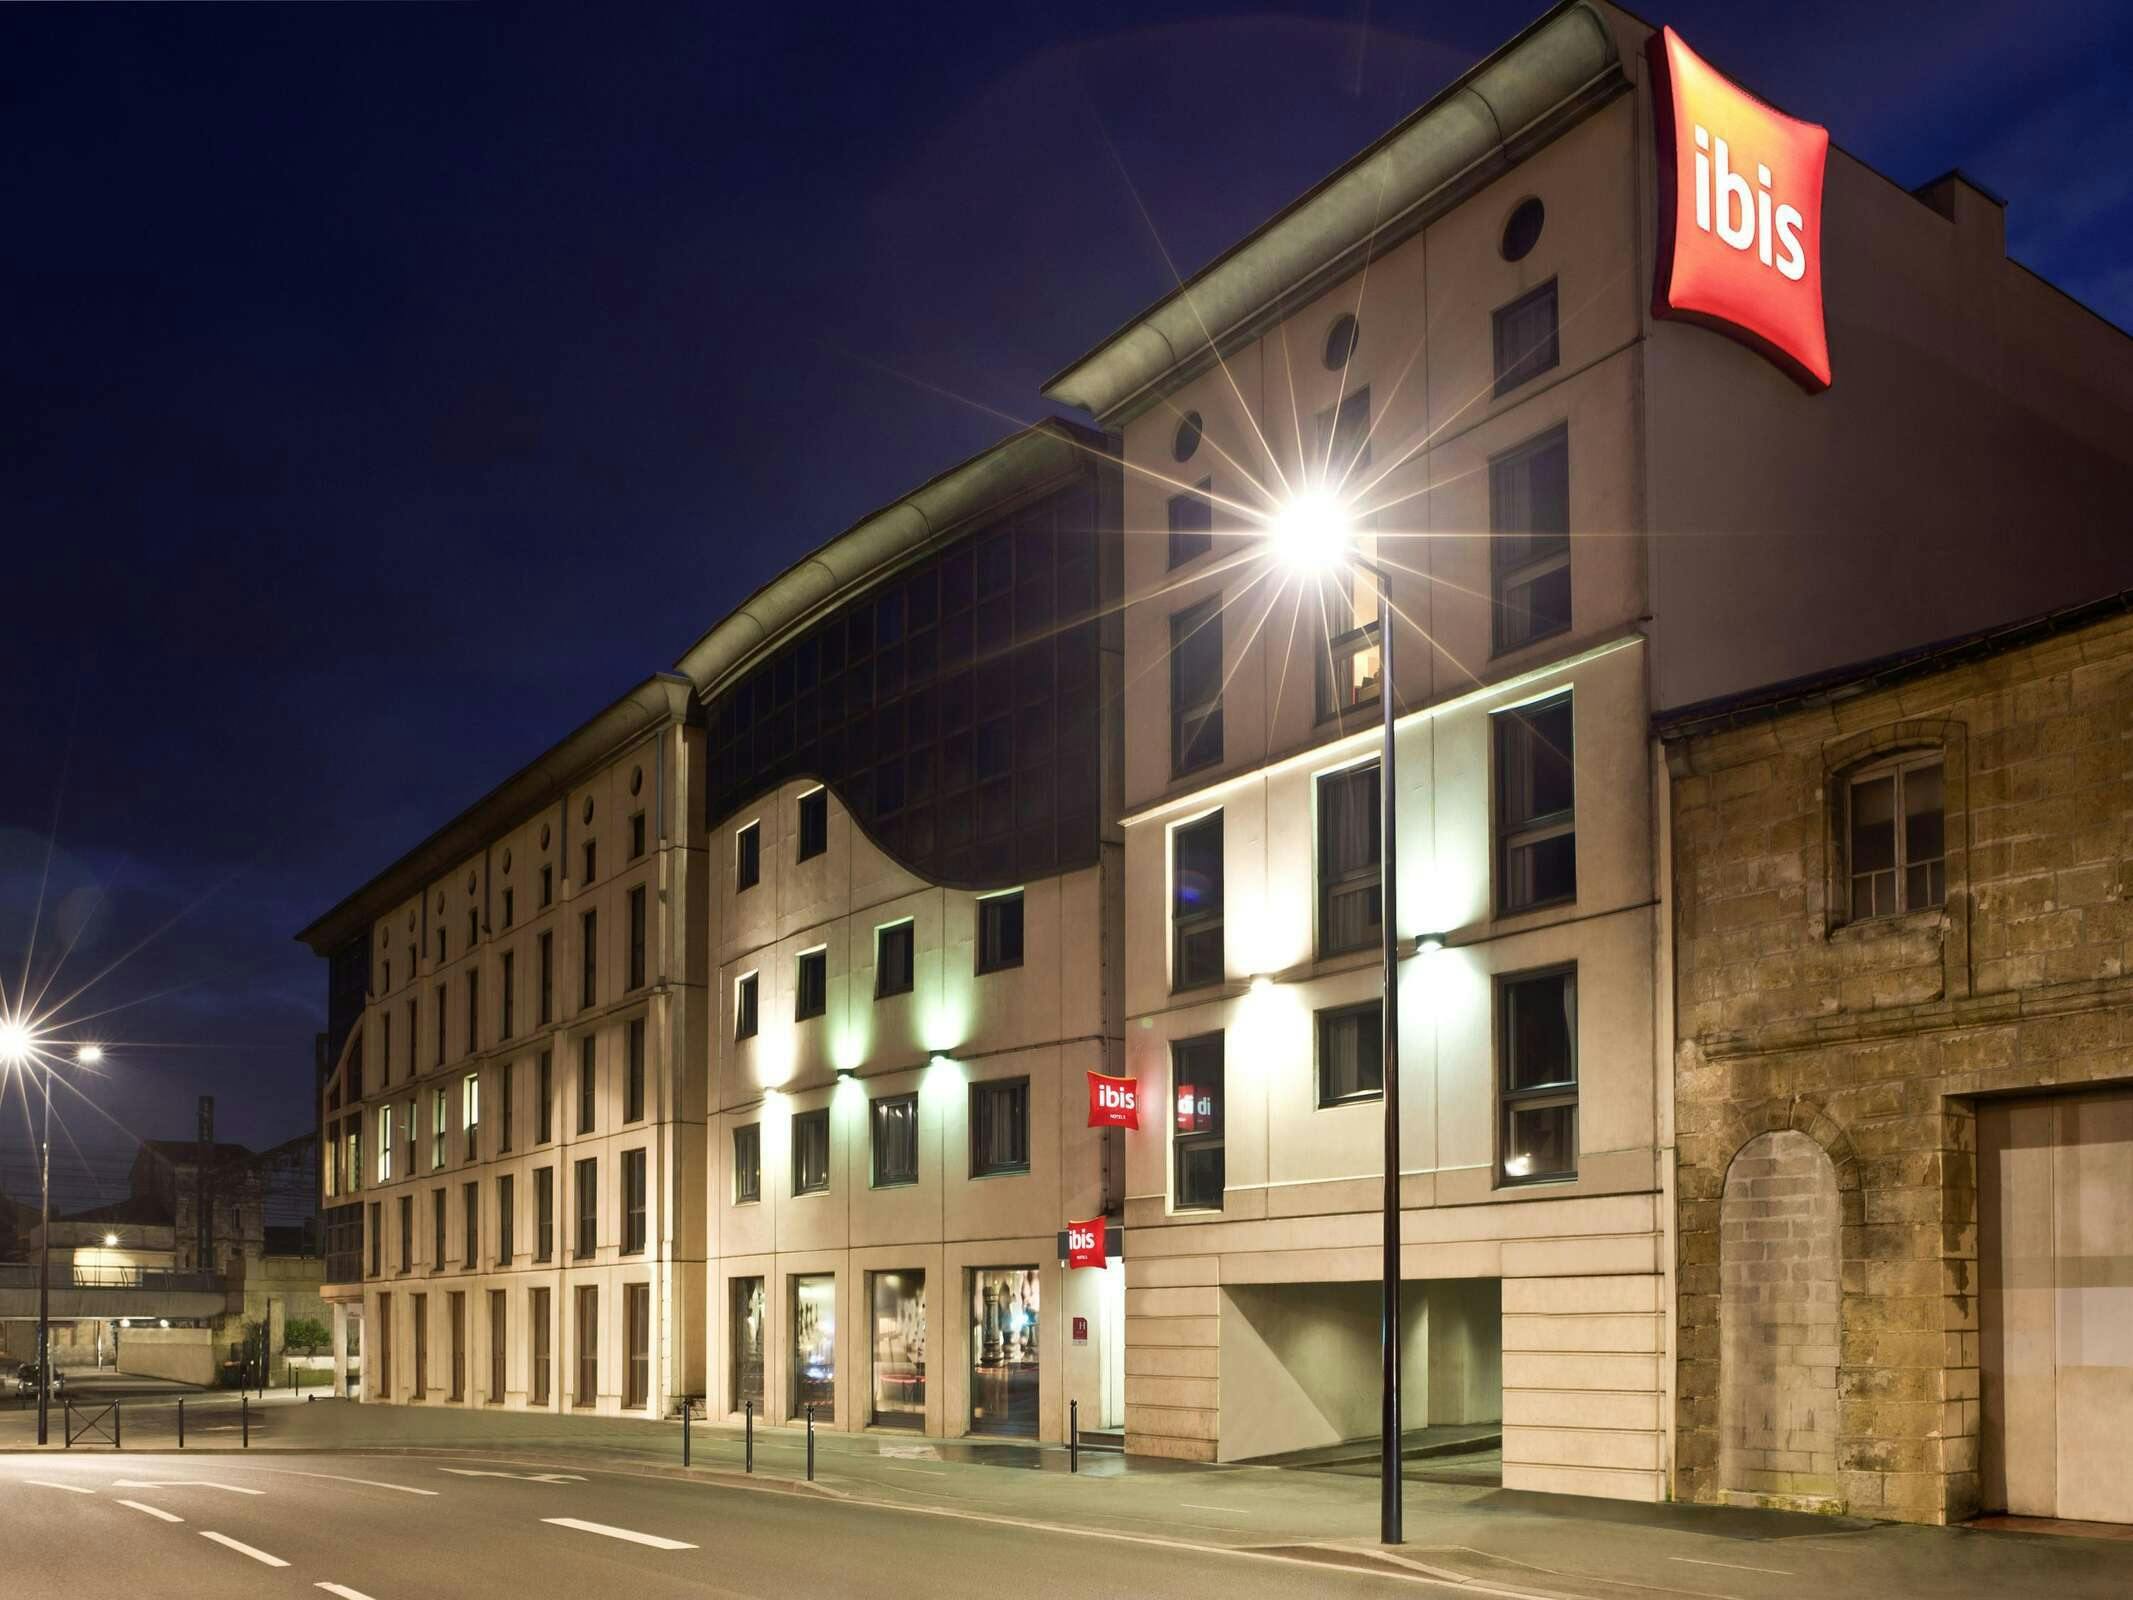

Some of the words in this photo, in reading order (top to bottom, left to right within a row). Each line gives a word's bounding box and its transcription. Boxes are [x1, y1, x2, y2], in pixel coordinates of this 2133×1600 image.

[1695, 124, 1805, 281] ibis
[1099, 1084, 1135, 1110] ibis
[1069, 1228, 1095, 1250] ibis
